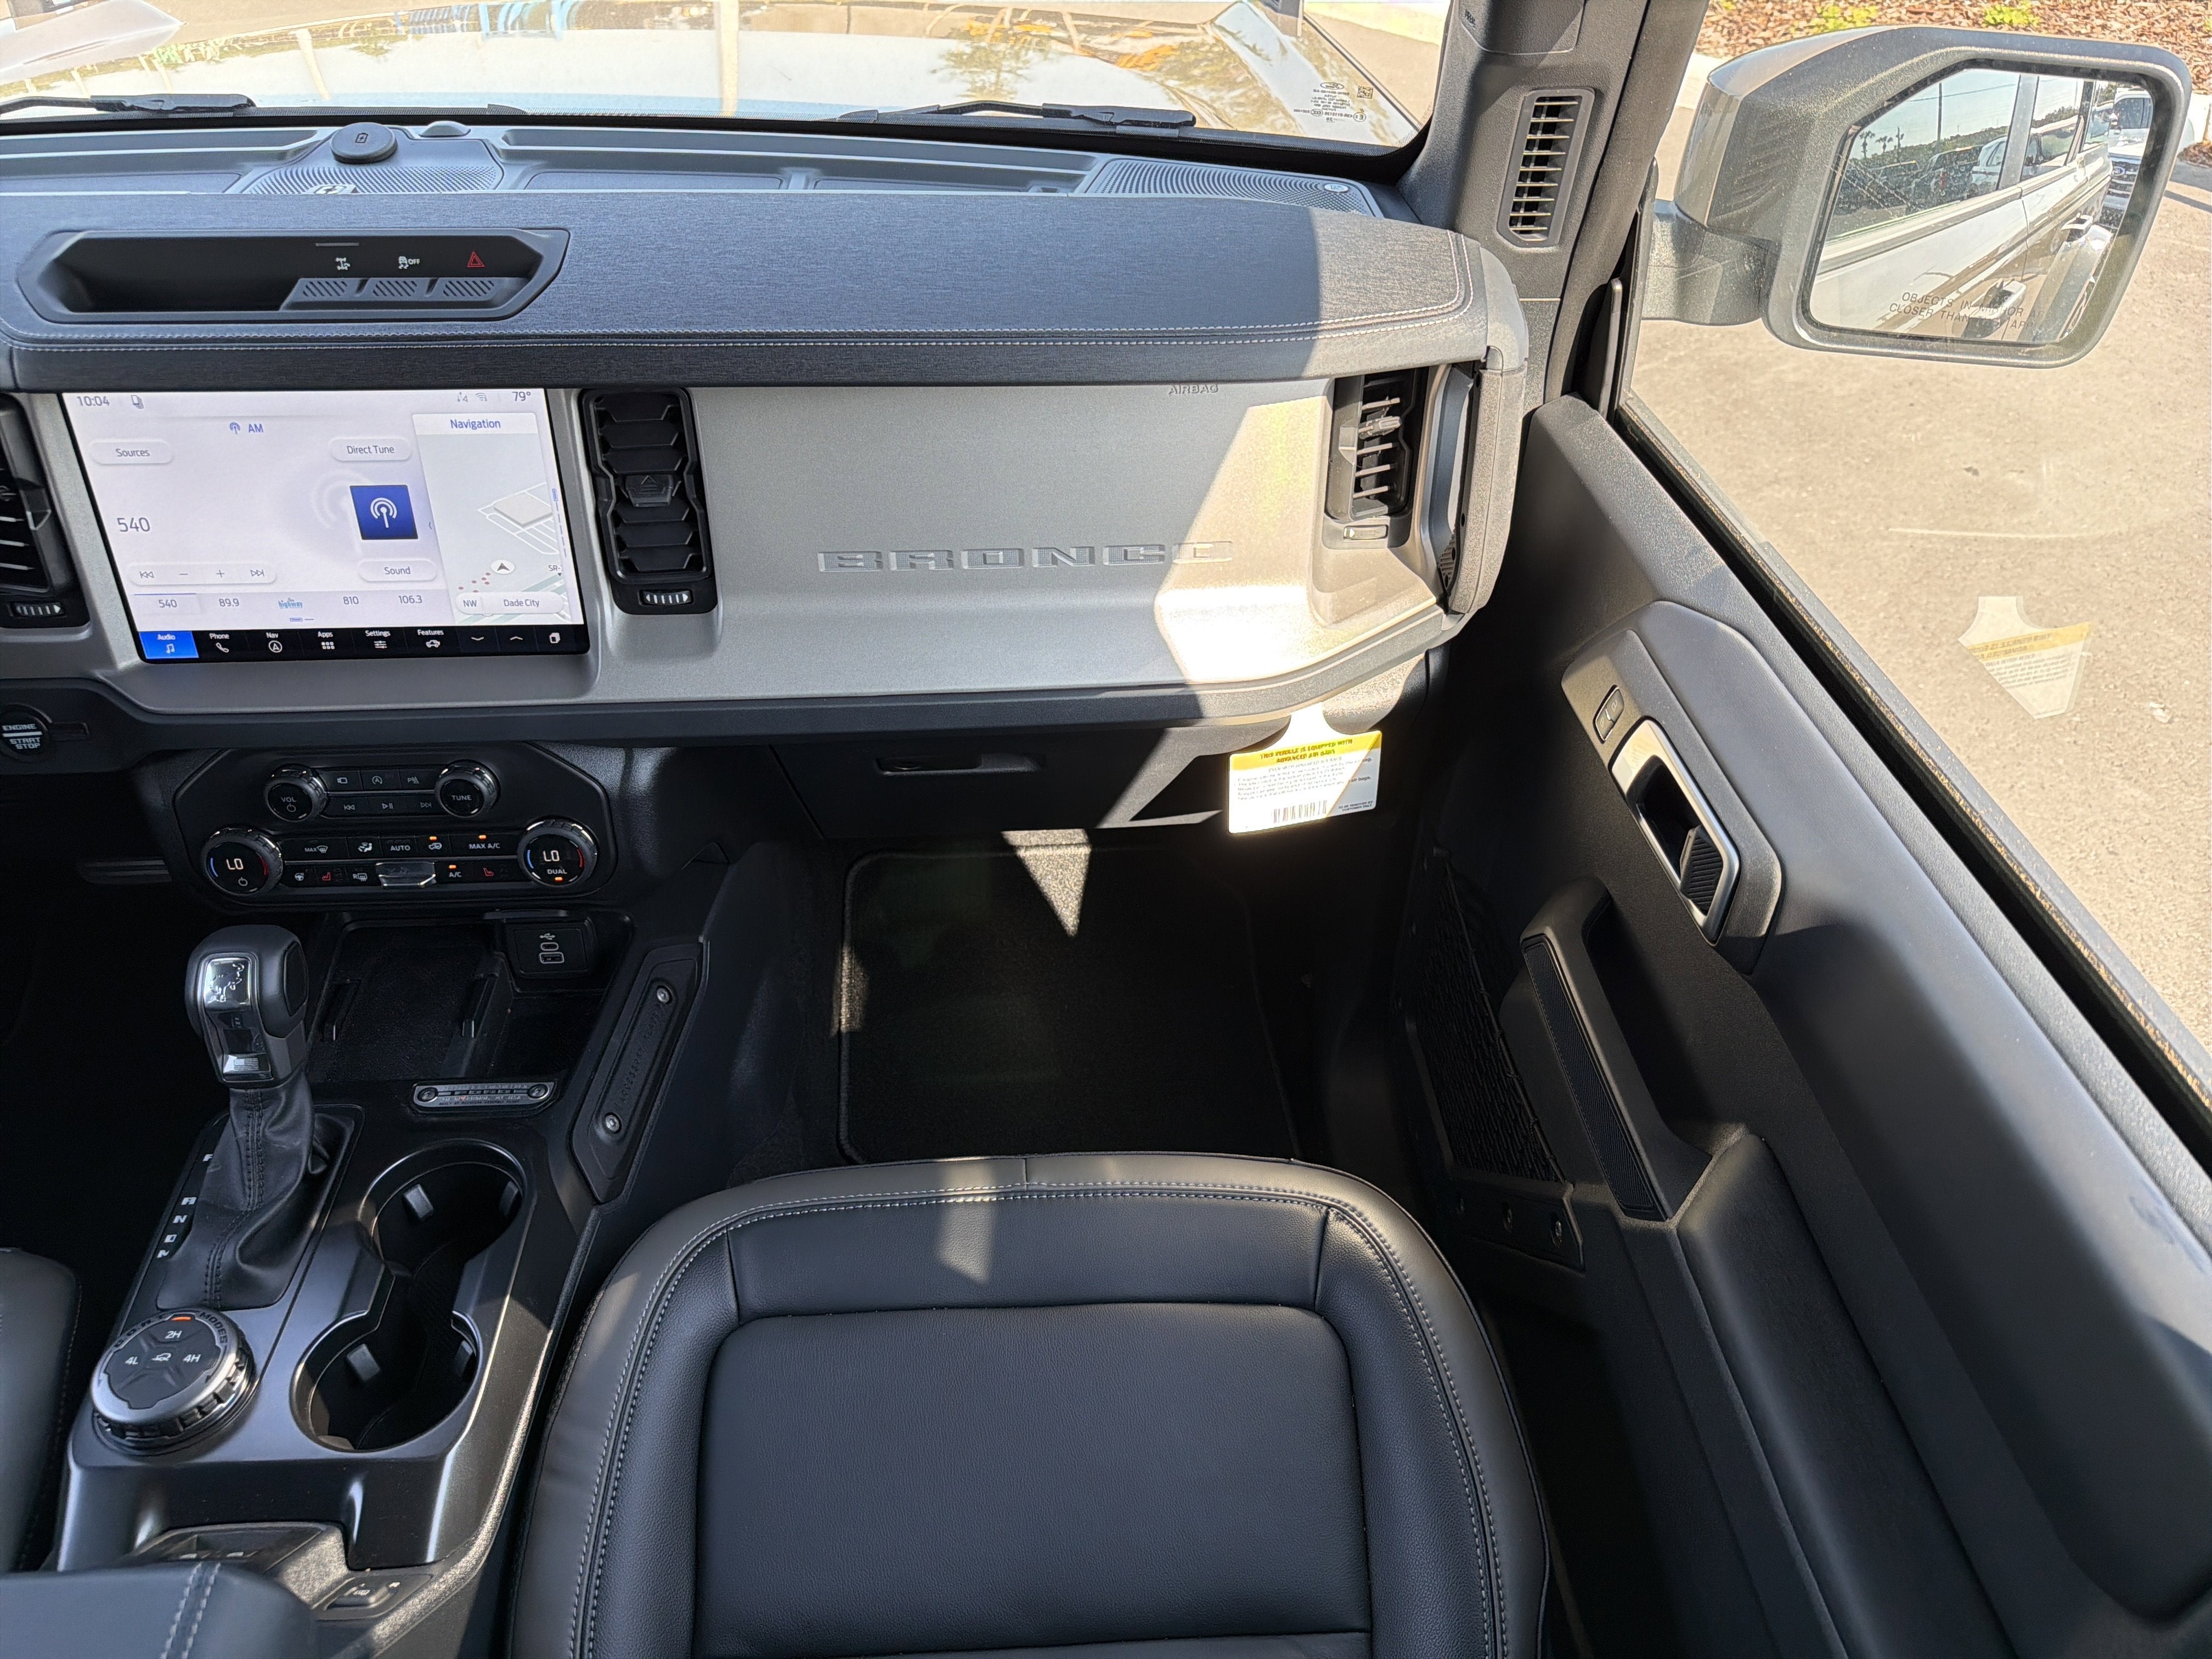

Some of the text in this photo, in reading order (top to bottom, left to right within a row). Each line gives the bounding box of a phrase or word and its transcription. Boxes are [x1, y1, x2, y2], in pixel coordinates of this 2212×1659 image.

[1902, 292, 1954, 308] OBJECTS
[1960, 300, 1971, 310] IN
[1889, 303, 1934, 318] CLOSER
[1940, 310, 1970, 322] THAN
[1169, 384, 1218, 394] AIRBAG
[77, 395, 110, 407] 10:04
[512, 391, 531, 402] 79°
[248, 424, 264, 433] AM
[450, 419, 501, 431] Navigation
[116, 448, 150, 458] Sources
[347, 445, 394, 454] Direct Tune
[117, 517, 150, 533] 540
[817, 540, 1233, 572] BRONCO
[384, 567, 411, 575] Sound
[159, 599, 177, 608] 540
[219, 598, 240, 607] 89.9
[278, 600, 303, 609] highway
[343, 596, 359, 605] 810
[398, 595, 422, 605] 106.3
[504, 599, 540, 608] Dade City
[318, 631, 333, 639] Apps
[365, 629, 391, 639] Settings
[173, 1215, 188, 1223] N
[164, 1234, 177, 1243] D
[199, 1312, 228, 1344] MODES
[165, 1330, 182, 1339] 2H
[125, 1356, 139, 1365] 4L
[183, 1354, 201, 1363] 4H
